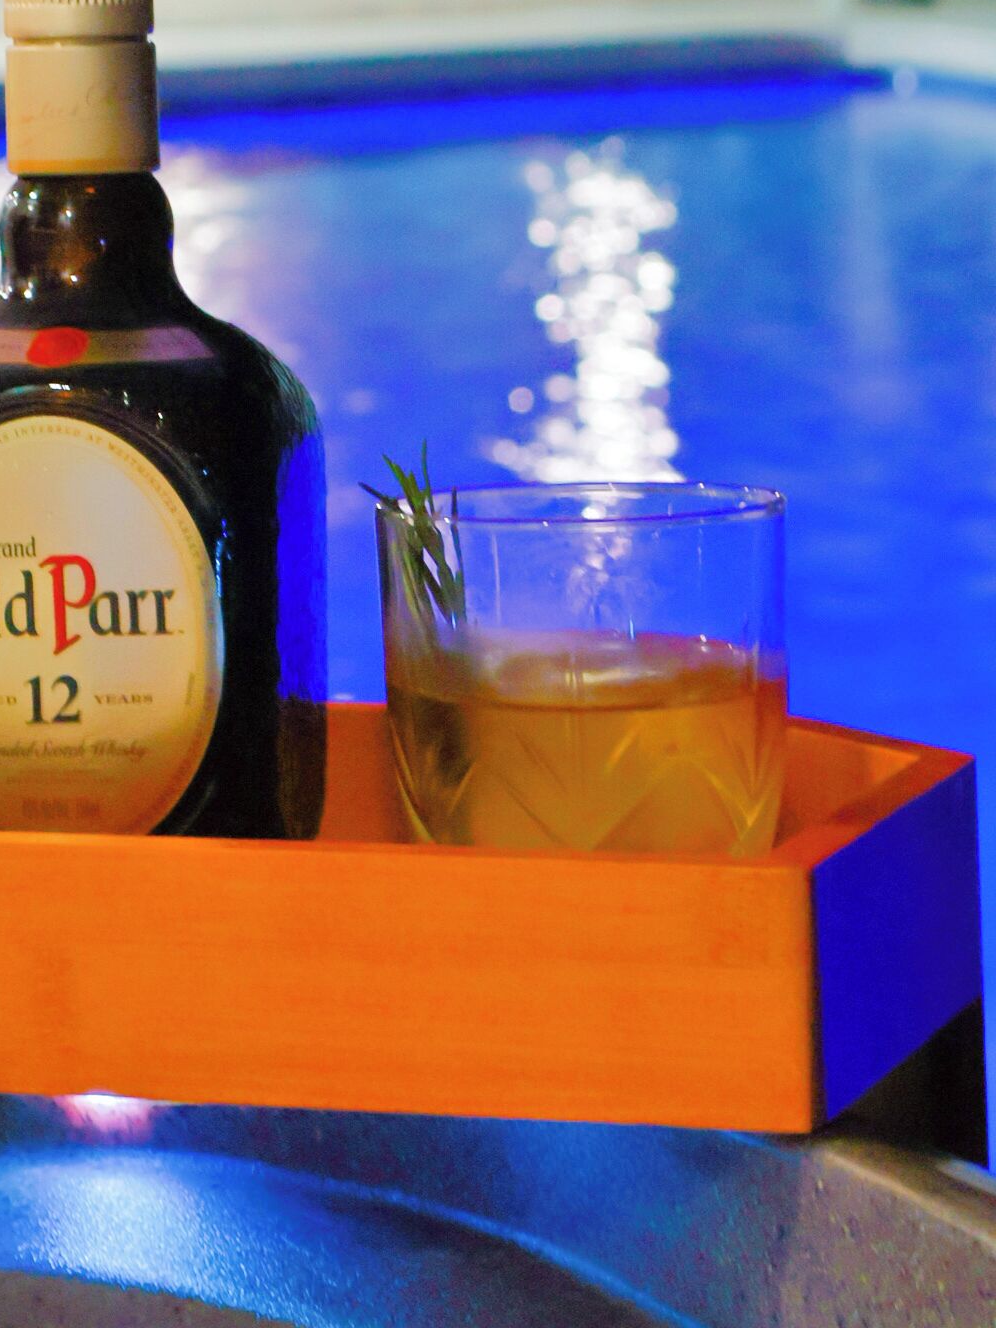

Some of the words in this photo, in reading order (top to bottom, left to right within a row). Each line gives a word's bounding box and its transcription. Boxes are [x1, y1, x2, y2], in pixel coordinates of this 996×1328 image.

[39, 555, 175, 655] Parr
[23, 674, 82, 725] 12
[94, 693, 154, 706] YEARS
